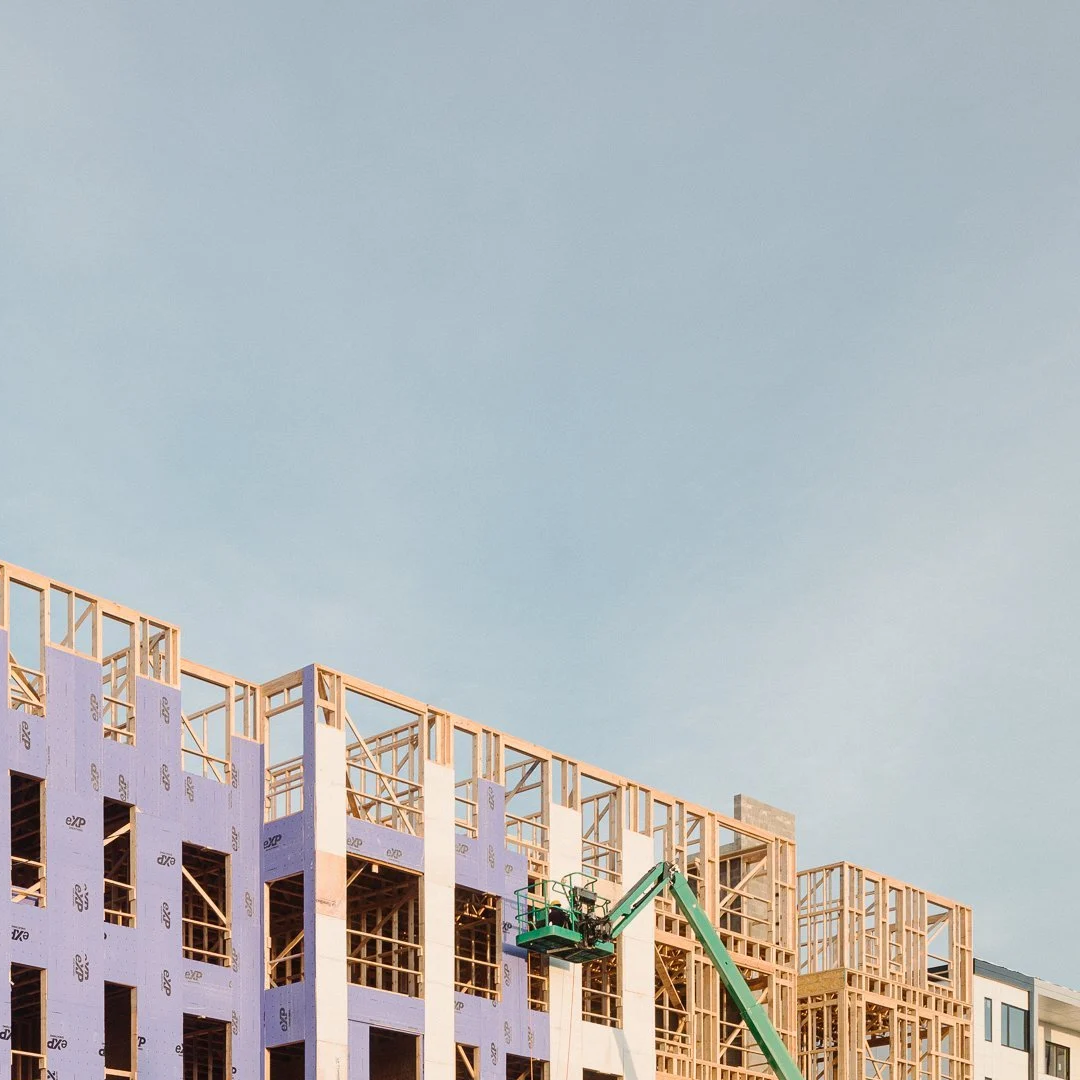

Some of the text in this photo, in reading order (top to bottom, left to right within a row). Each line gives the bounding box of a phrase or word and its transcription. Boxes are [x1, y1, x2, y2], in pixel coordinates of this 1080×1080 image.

[22, 720, 30, 750] eXP
[66, 815, 86, 827] eXP
[264, 834, 282, 849] eXP
[157, 855, 176, 867] eXP
[75, 884, 83, 912] eXP
[75, 954, 83, 982] eXP
[279, 1007, 288, 1032] eXP
[47, 1038, 67, 1050] eXP
